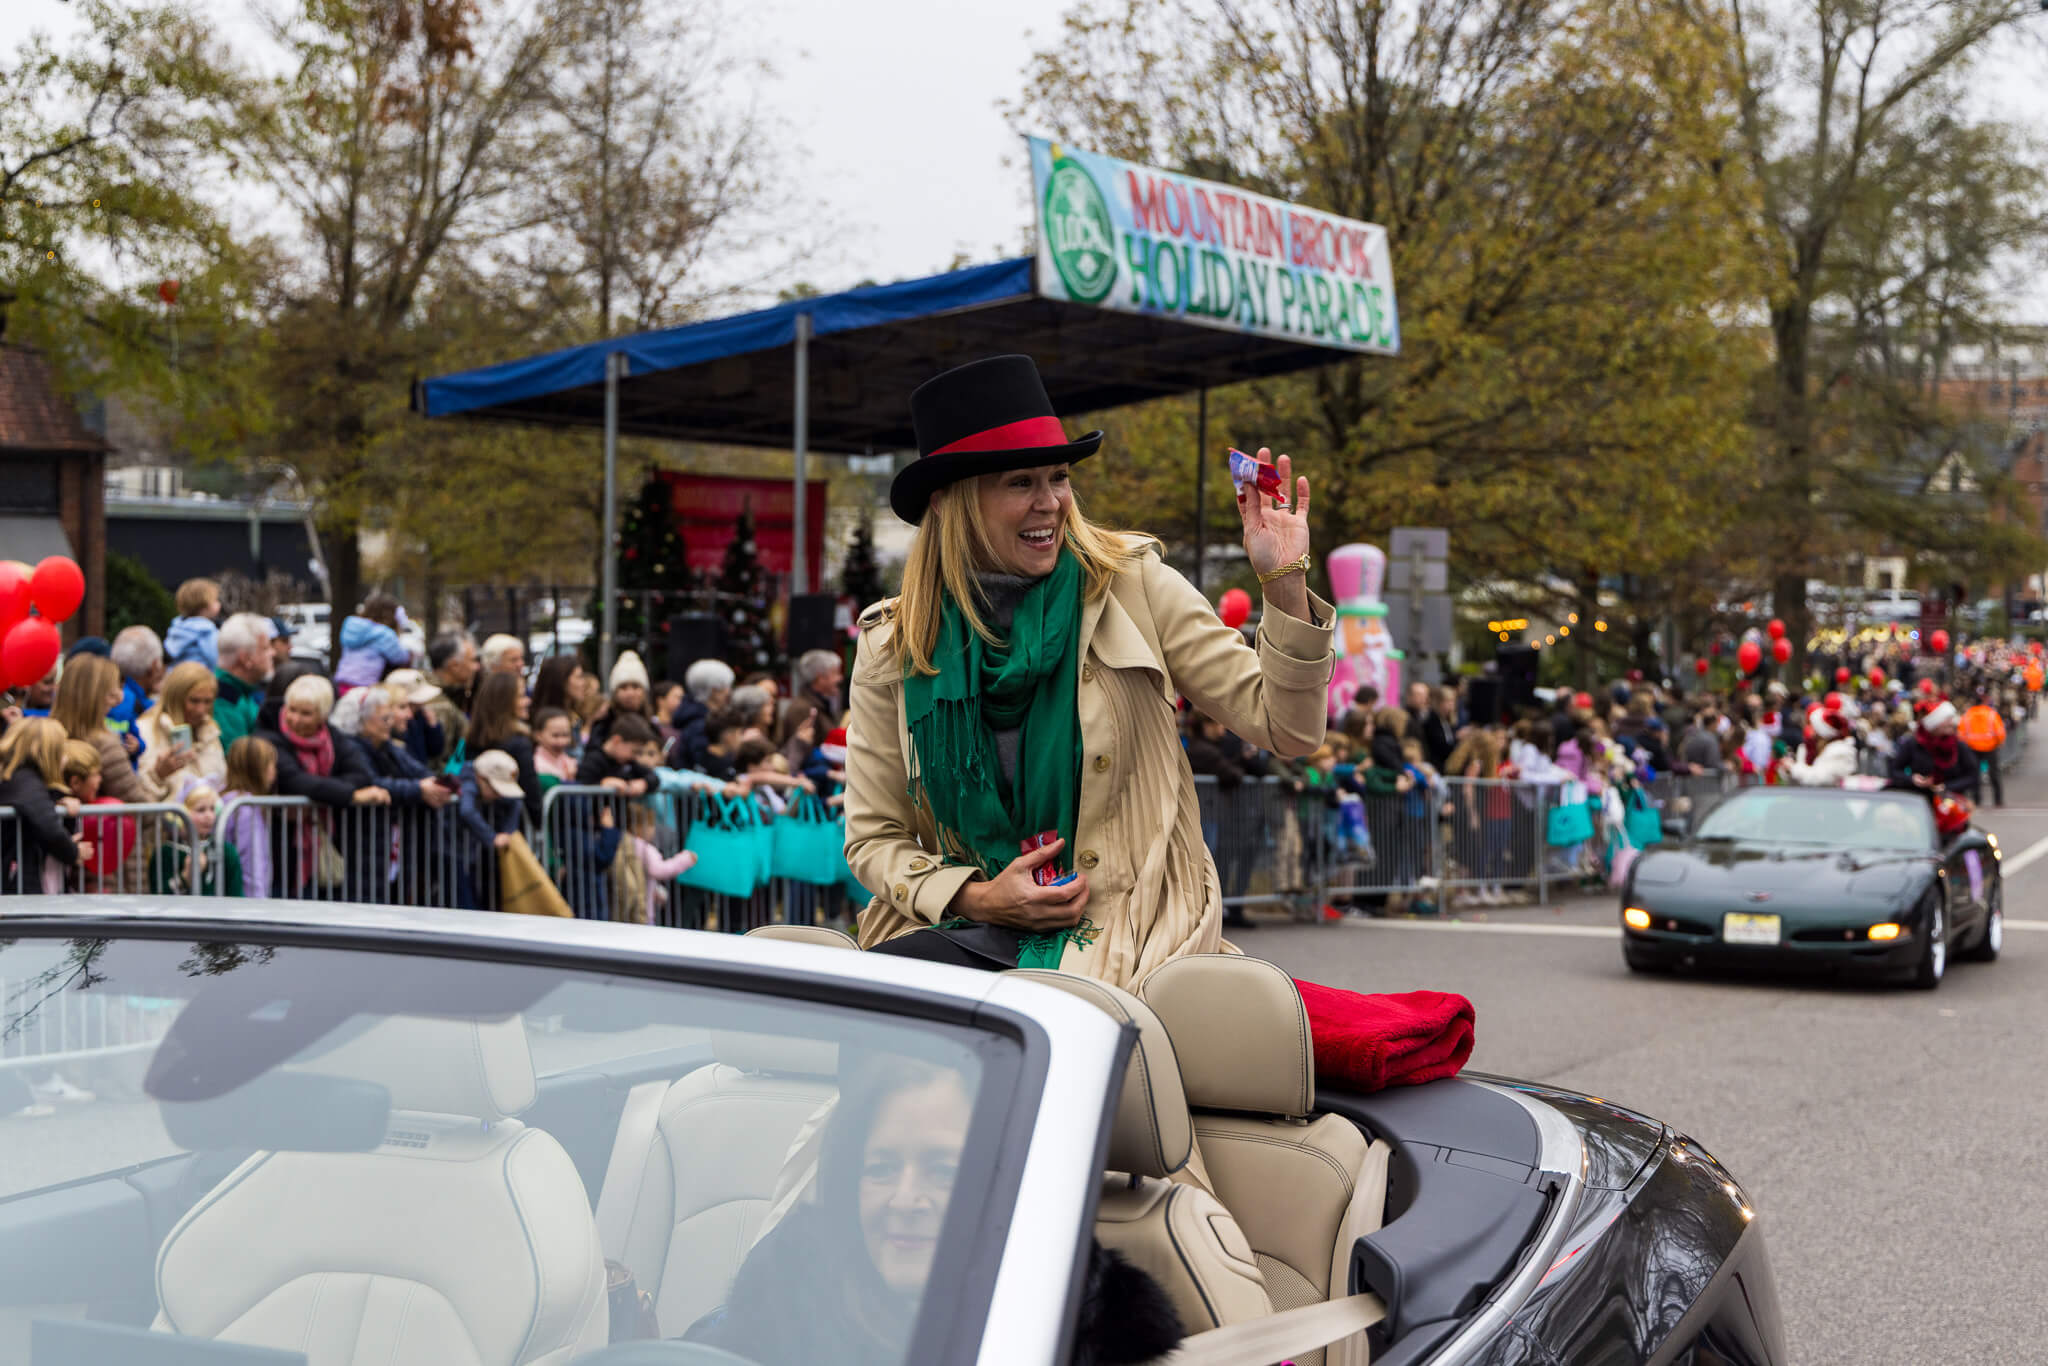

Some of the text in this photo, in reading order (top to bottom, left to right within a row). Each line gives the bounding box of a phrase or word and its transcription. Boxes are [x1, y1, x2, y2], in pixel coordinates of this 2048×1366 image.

[1126, 169, 1374, 280] MOUNTAIN BROOK
[1123, 233, 1391, 348] HOLIDAY PARADE
